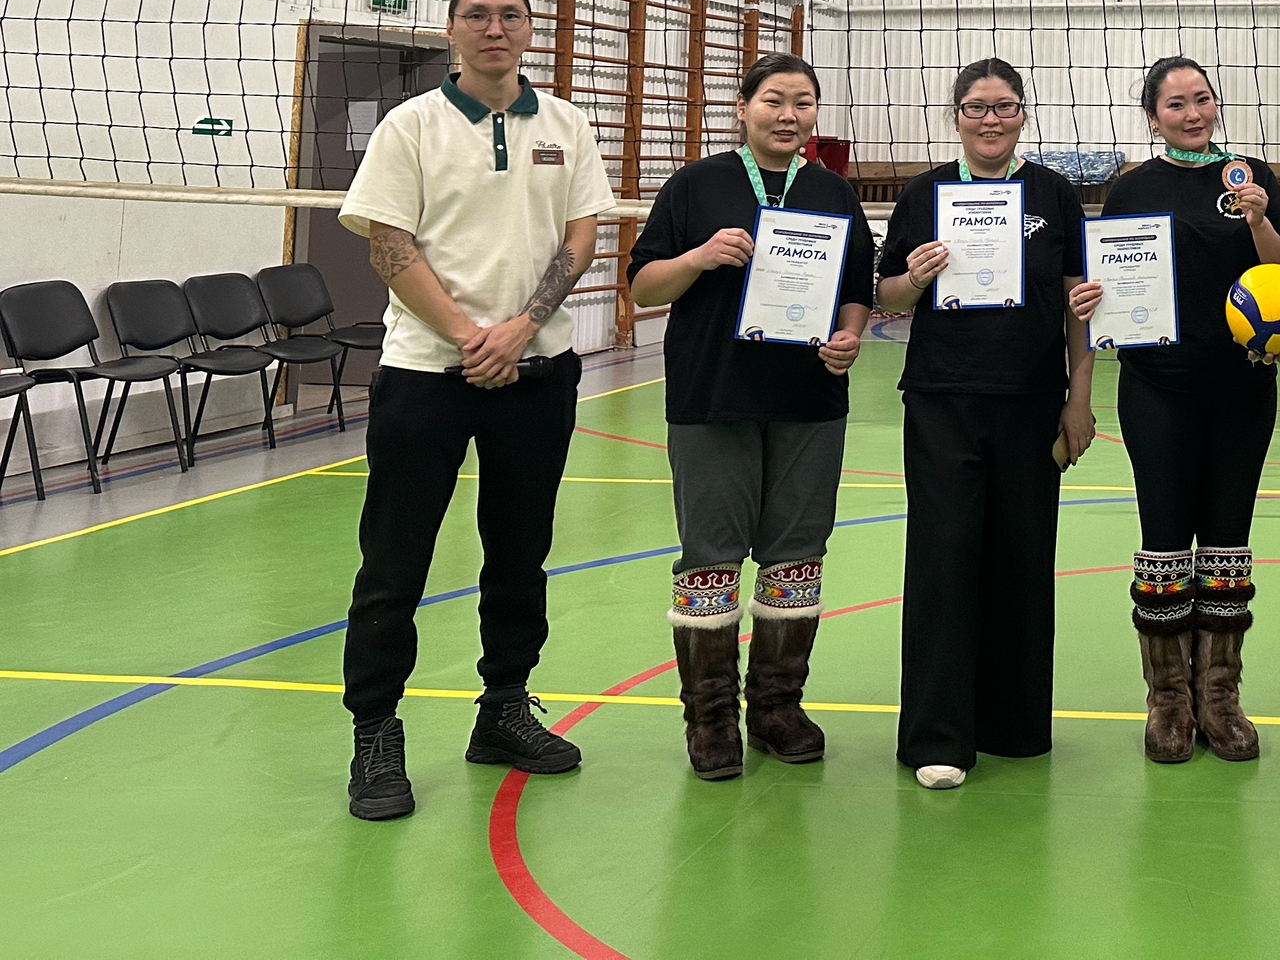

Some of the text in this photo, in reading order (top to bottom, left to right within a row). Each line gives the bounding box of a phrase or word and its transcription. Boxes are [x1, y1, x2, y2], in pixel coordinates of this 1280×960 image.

[952, 216, 1007, 227] ГРАМОТА
[769, 245, 827, 261] ГРАМОТА
[1101, 251, 1158, 265] ГРАМОТА
